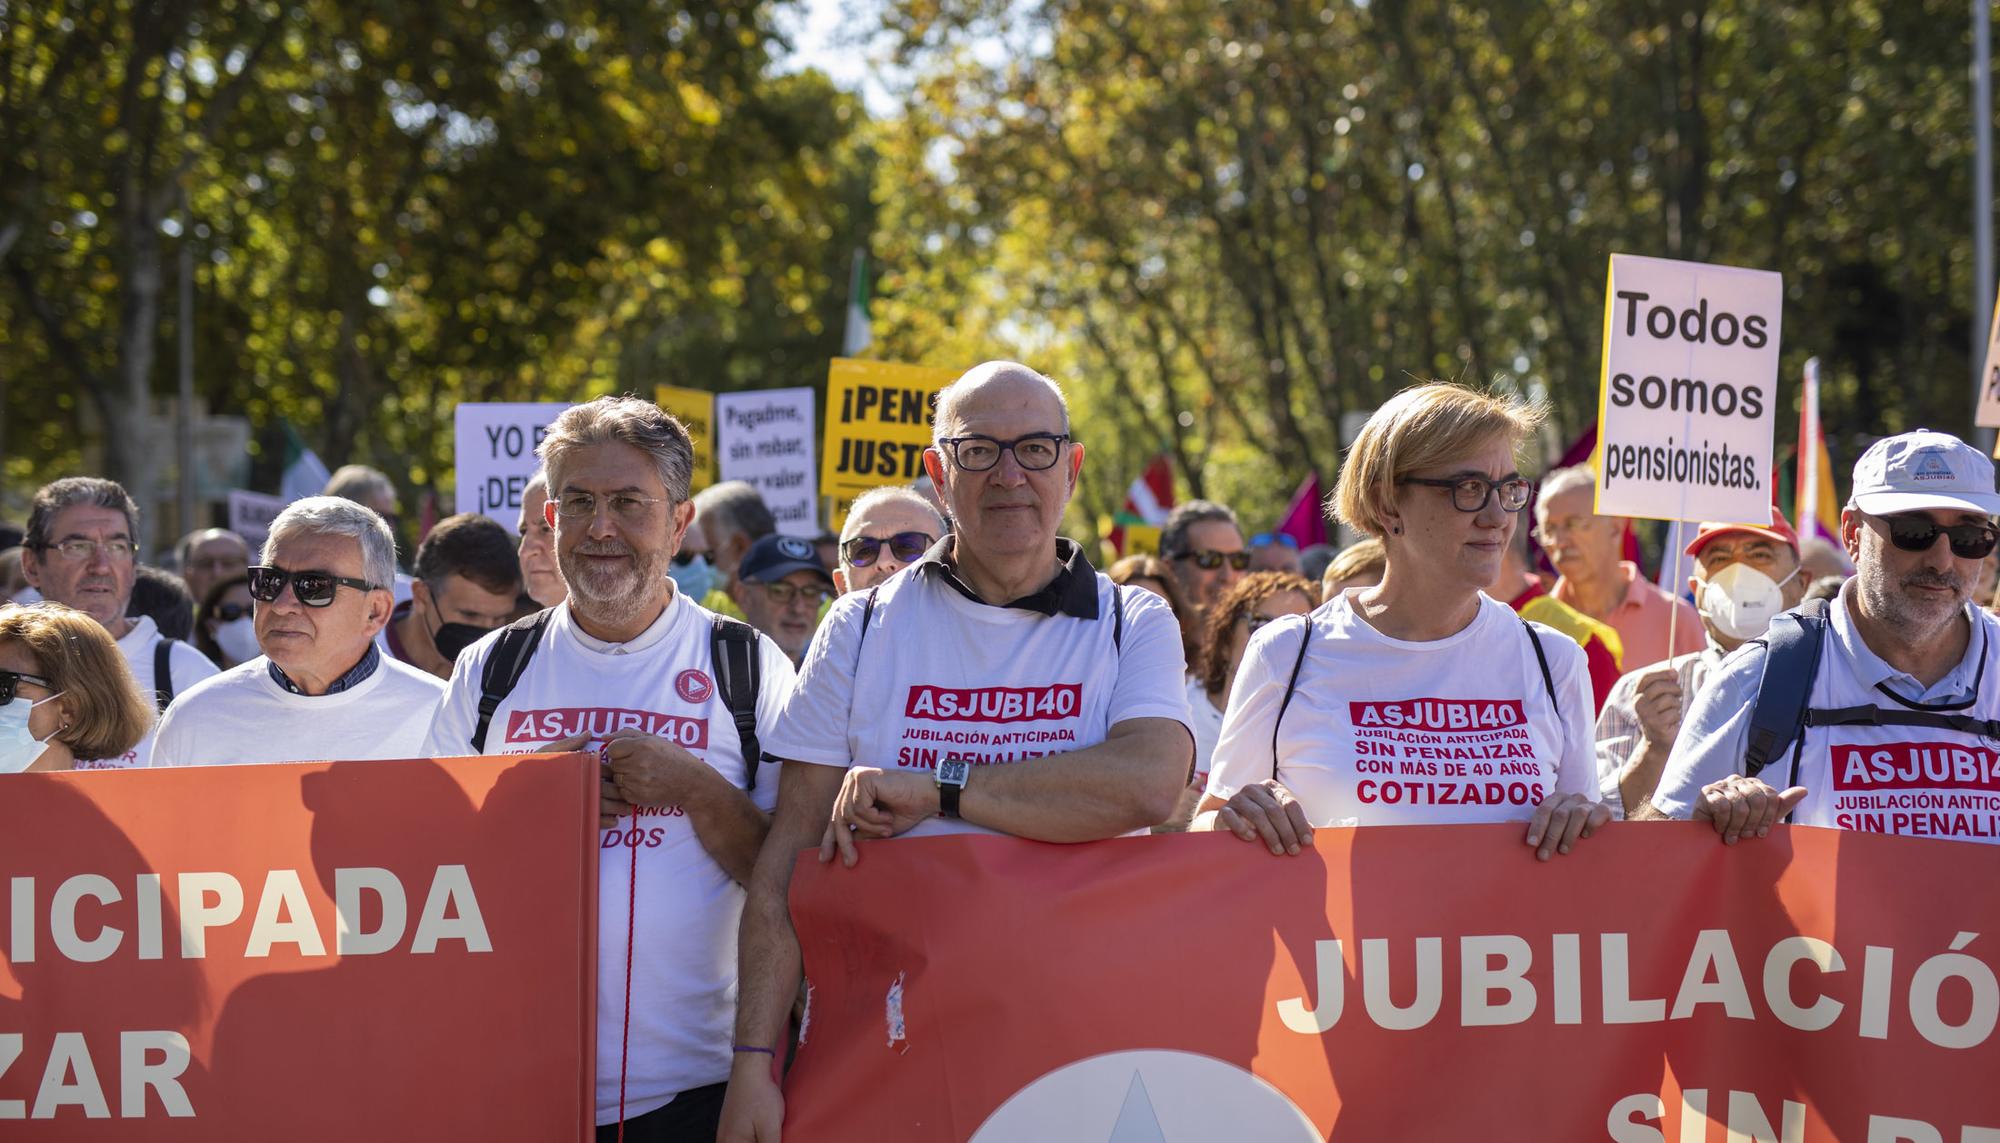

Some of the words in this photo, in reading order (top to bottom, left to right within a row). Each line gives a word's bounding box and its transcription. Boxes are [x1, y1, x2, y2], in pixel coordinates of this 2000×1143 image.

[1617, 290, 1768, 349] Todos
[1611, 373, 1763, 419] somos
[485, 425, 524, 458] YO
[1606, 436, 1760, 490] pensionistas.
[912, 688, 1076, 719] ASJUBI40
[1360, 701, 1517, 729] ASJUBI40
[902, 728, 989, 746] JUBILACIÓN
[992, 729, 1076, 746] ANTICIPADA
[1354, 729, 1442, 744] JUBILACIÓN
[1446, 729, 1529, 744] ANTICIPADA
[1355, 741, 1396, 758] SIN
[1405, 743, 1537, 760] PENALIZAR
[897, 747, 938, 769] SIN
[1356, 760, 1394, 775] CON
[1400, 760, 1438, 776] MÁS
[1444, 763, 1467, 777] DE
[1473, 763, 1493, 776] 40
[1500, 759, 1541, 777] AÑOS
[1357, 779, 1545, 807] COTIZADOS
[1834, 792, 1944, 811] JUBILACIÓN
[1836, 813, 1886, 834] SIN
[1892, 813, 2000, 837] PENALI
[10, 864, 494, 963] ICIPADA
[1276, 929, 2000, 1049] JUBILACIÓ
